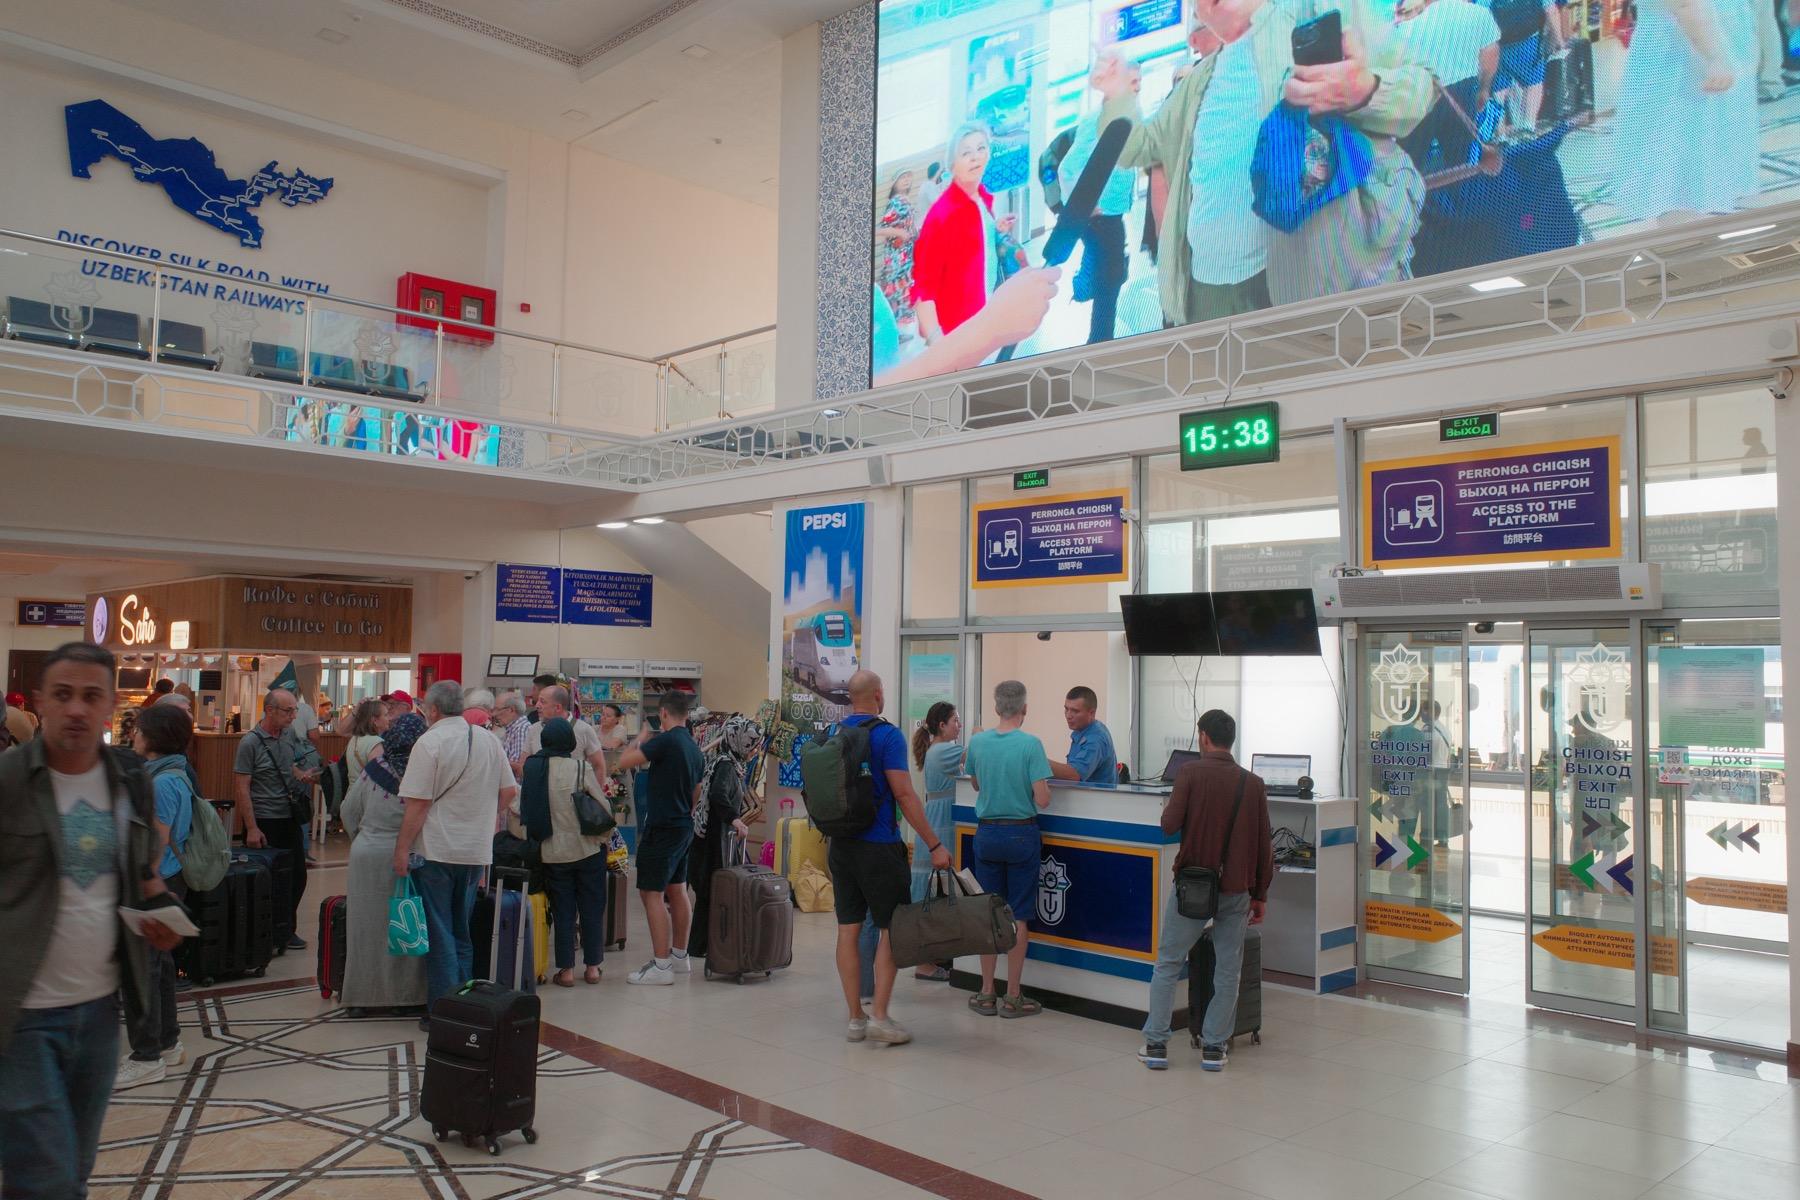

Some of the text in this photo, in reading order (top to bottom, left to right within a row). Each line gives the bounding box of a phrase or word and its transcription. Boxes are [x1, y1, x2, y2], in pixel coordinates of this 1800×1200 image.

[80, 259, 304, 315] UZBEKSTAN RAILWAYS
[1454, 417, 1480, 427] EXIT
[1184, 418, 1270, 453] 15:38
[1446, 424, 1491, 437] ВЫХОД
[1458, 458, 1590, 479] PERRONGA CHIQISH
[1016, 478, 1045, 488] ВЫХОД
[1023, 472, 1038, 480] EXIT
[1459, 478, 1590, 498] ВЫХОД НА ПЕРРОН
[1031, 504, 1112, 519] PERRONGA CHIQISH
[1472, 499, 1576, 516] ACCESS TO THE
[802, 512, 847, 531] PEPSI
[1488, 512, 1559, 526] PLATFORM
[1032, 520, 1112, 534] ВЫХОД НА ПЕРРОН
[1040, 536, 1104, 548] ACCESS TO THE
[1050, 546, 1093, 556] PLATFORM
[358, 617, 383, 636] Go
[792, 692, 814, 702] SIZGA
[790, 702, 813, 720] OQ
[1370, 740, 1430, 753] CHIQISH
[1373, 754, 1427, 768] ВЫХОД
[1384, 770, 1416, 782] EXIT
[1565, 762, 1632, 780] ВЫХОД
[1388, 785, 1411, 796] 出口
[1578, 780, 1617, 793] EXIT
[1585, 796, 1611, 810] 出口
